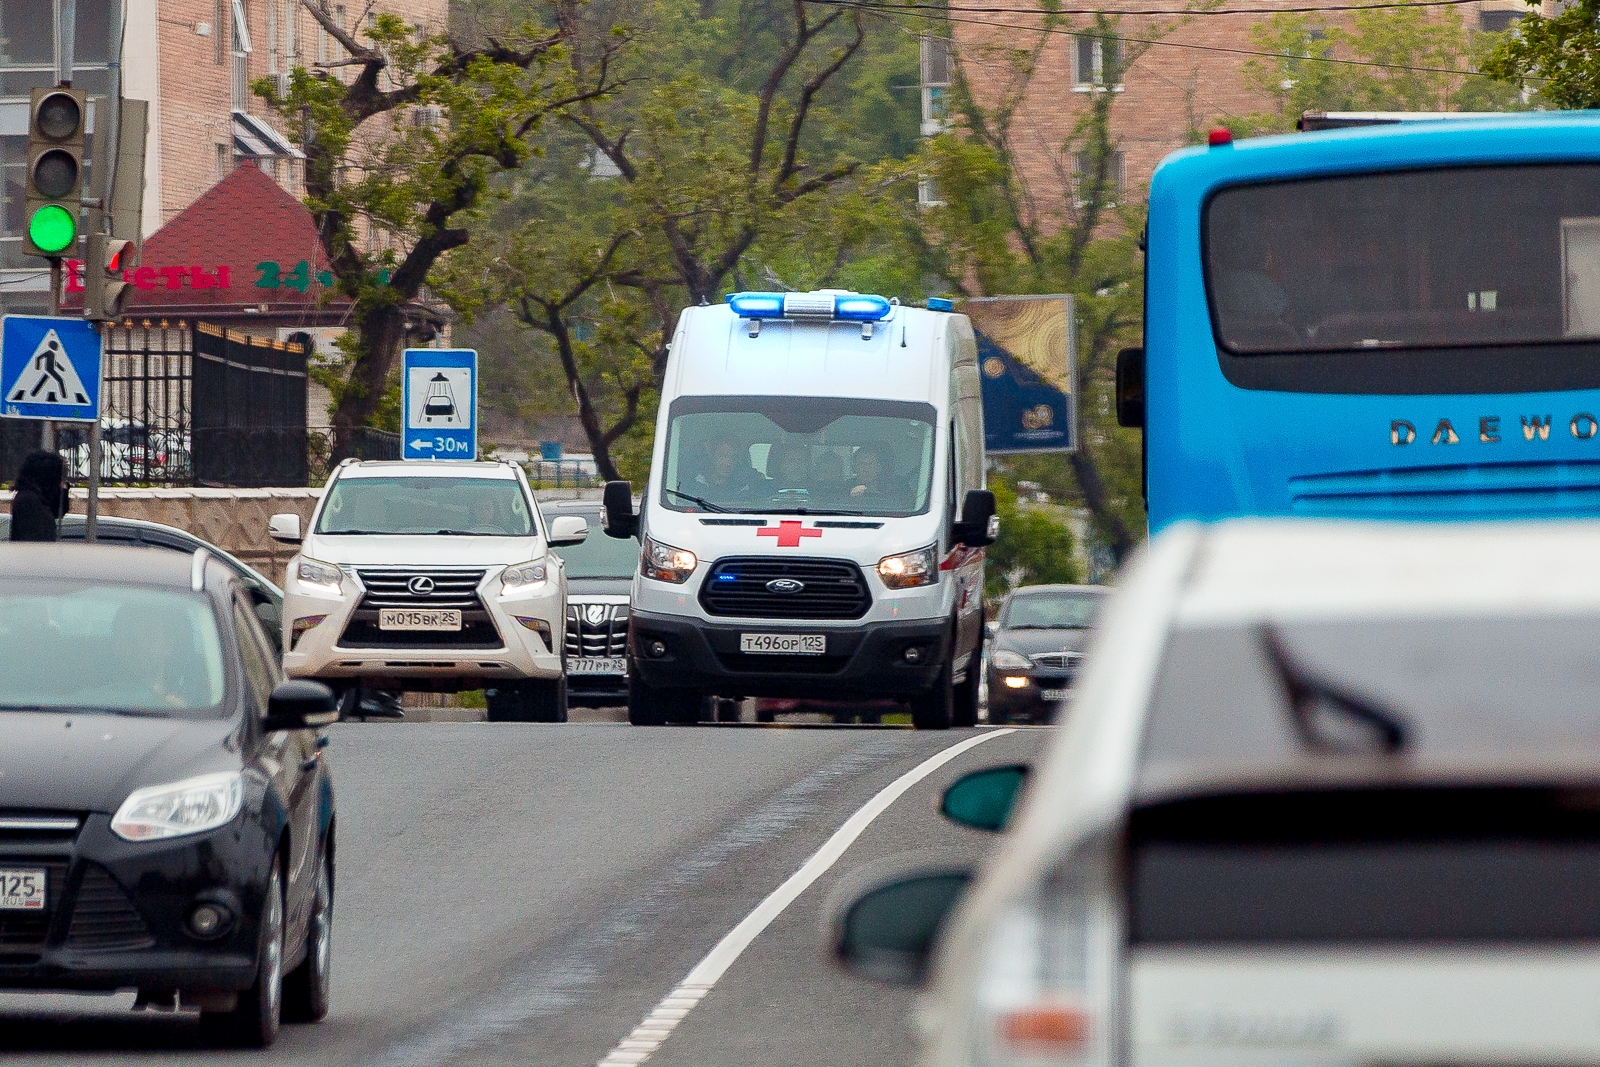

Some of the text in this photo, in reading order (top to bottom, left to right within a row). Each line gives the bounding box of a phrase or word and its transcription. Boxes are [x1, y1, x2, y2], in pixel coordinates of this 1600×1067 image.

[254, 260, 310, 293] 24
[801, 637, 823, 647] 125
[0, 875, 35, 897] 125
